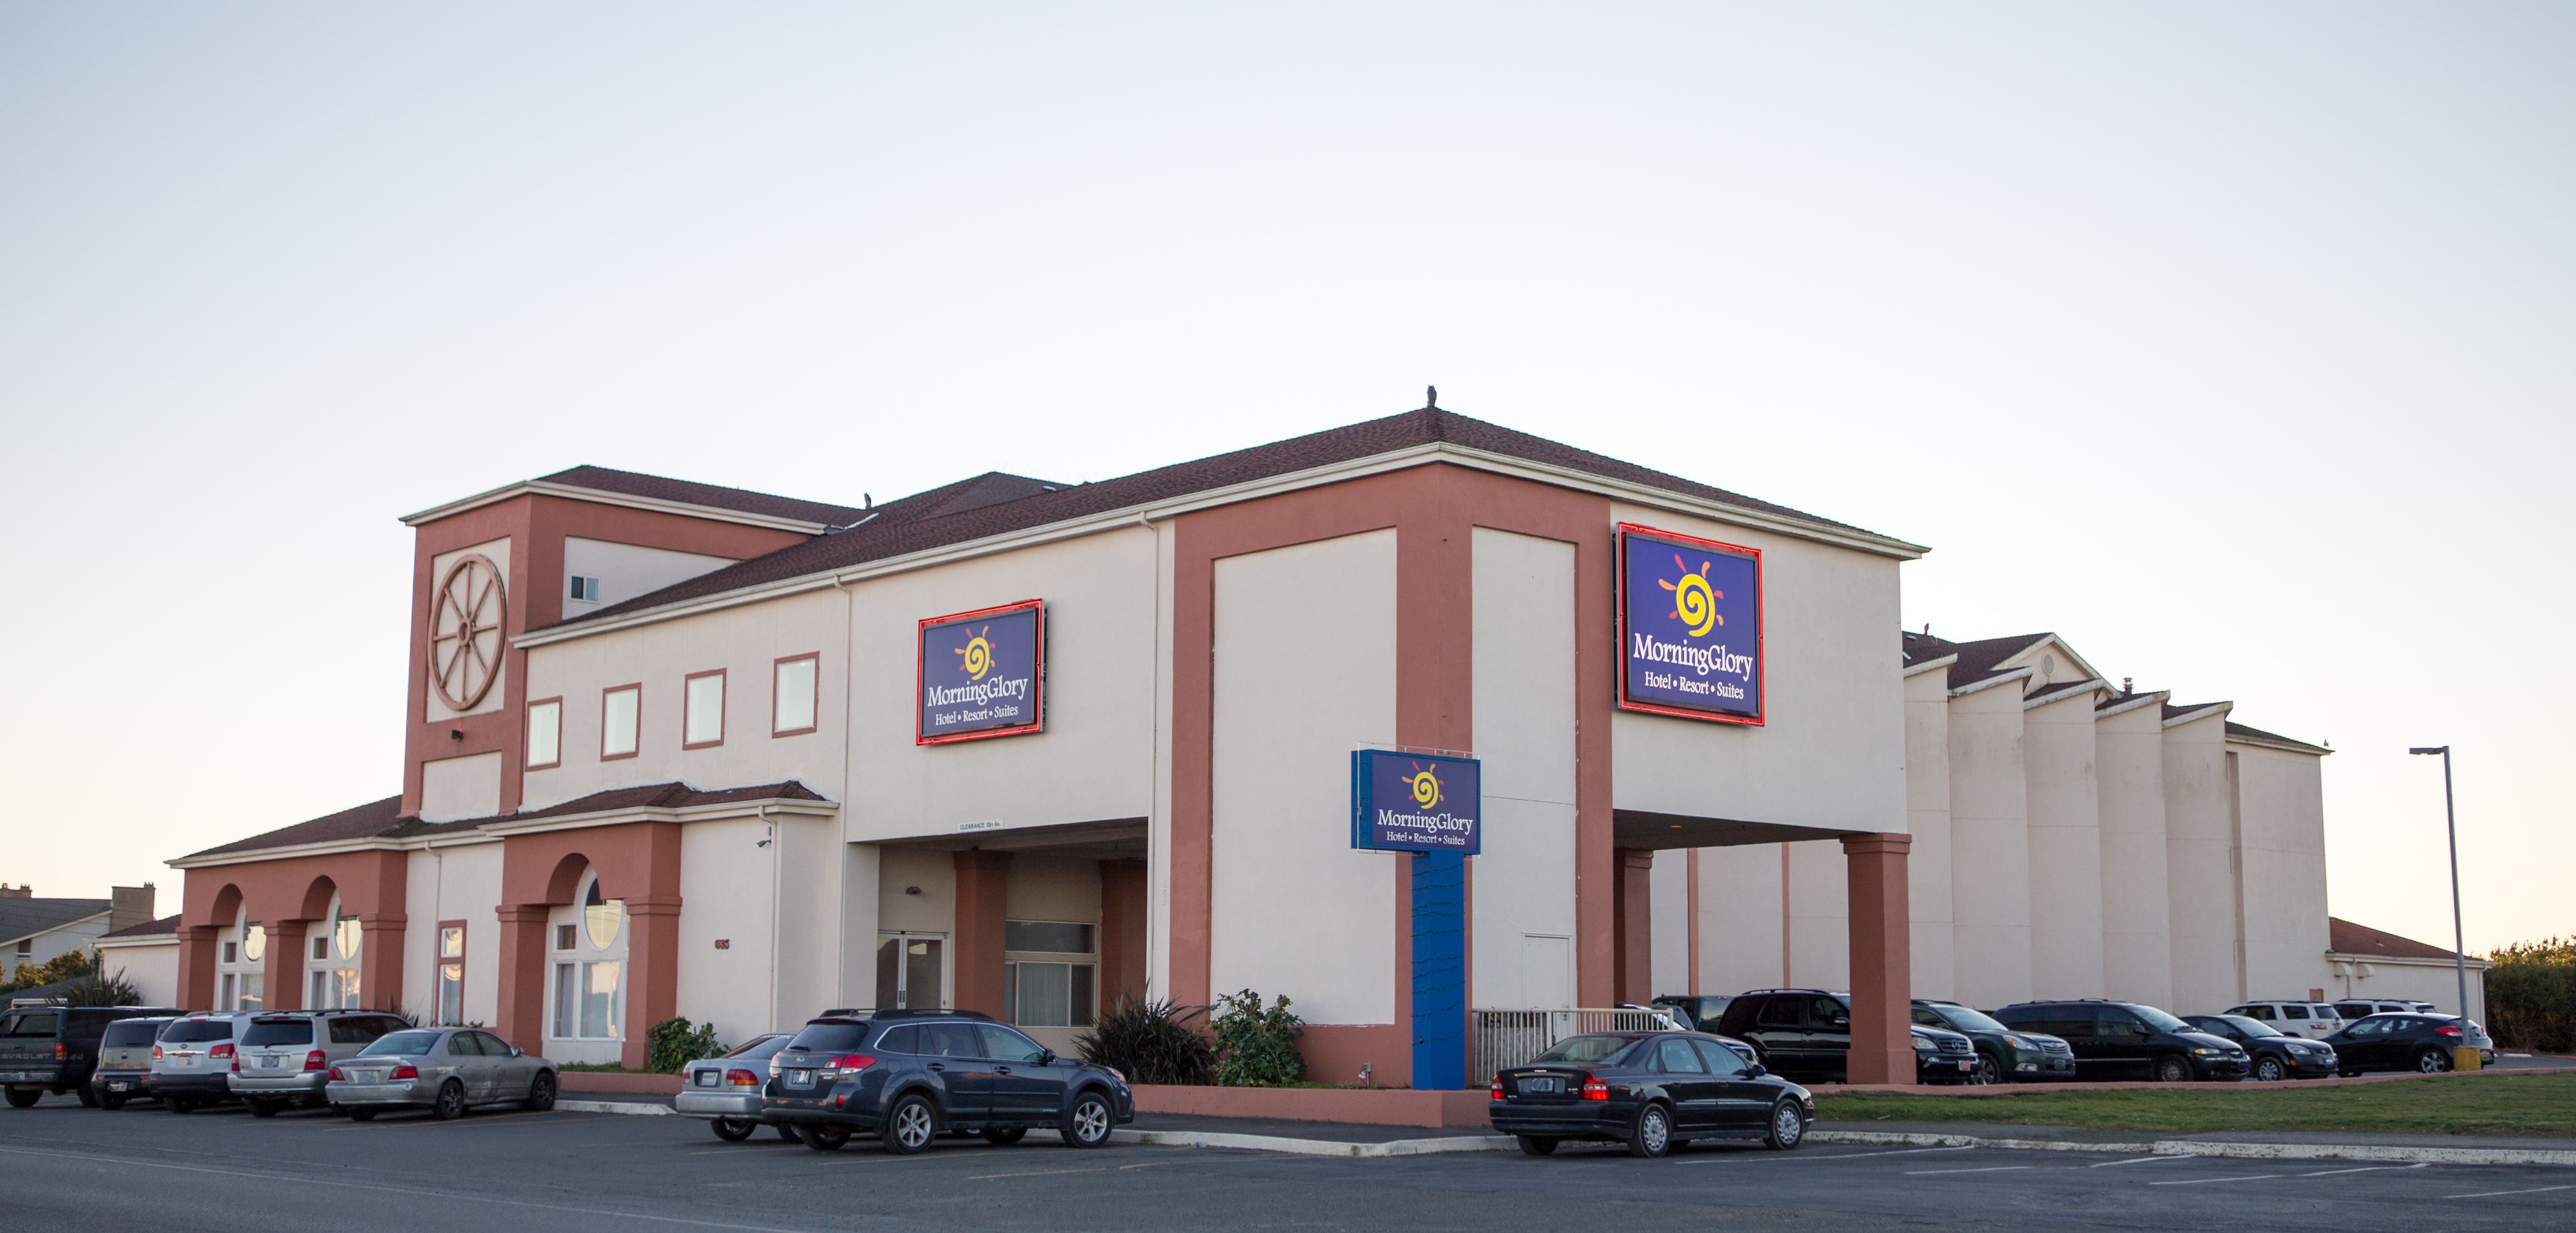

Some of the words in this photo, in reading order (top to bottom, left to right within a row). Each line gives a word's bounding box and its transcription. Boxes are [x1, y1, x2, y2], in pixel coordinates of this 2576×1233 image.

[1633, 633, 1753, 682] MorningGlory
[927, 675, 1028, 706] MorningGlory
[1645, 672, 1671, 689] Hotel
[1679, 676, 1709, 694] Resort
[1717, 682, 1744, 700] Suites
[935, 711, 956, 725] Hotel
[963, 708, 987, 722] Resort
[994, 704, 1018, 718] Suites
[959, 822, 985, 830] CLEARANCE
[1377, 809, 1473, 835] MorningGlory
[1387, 831, 1407, 841] Hotel
[1413, 833, 1437, 843] Resort
[1443, 835, 1465, 845] Suites
